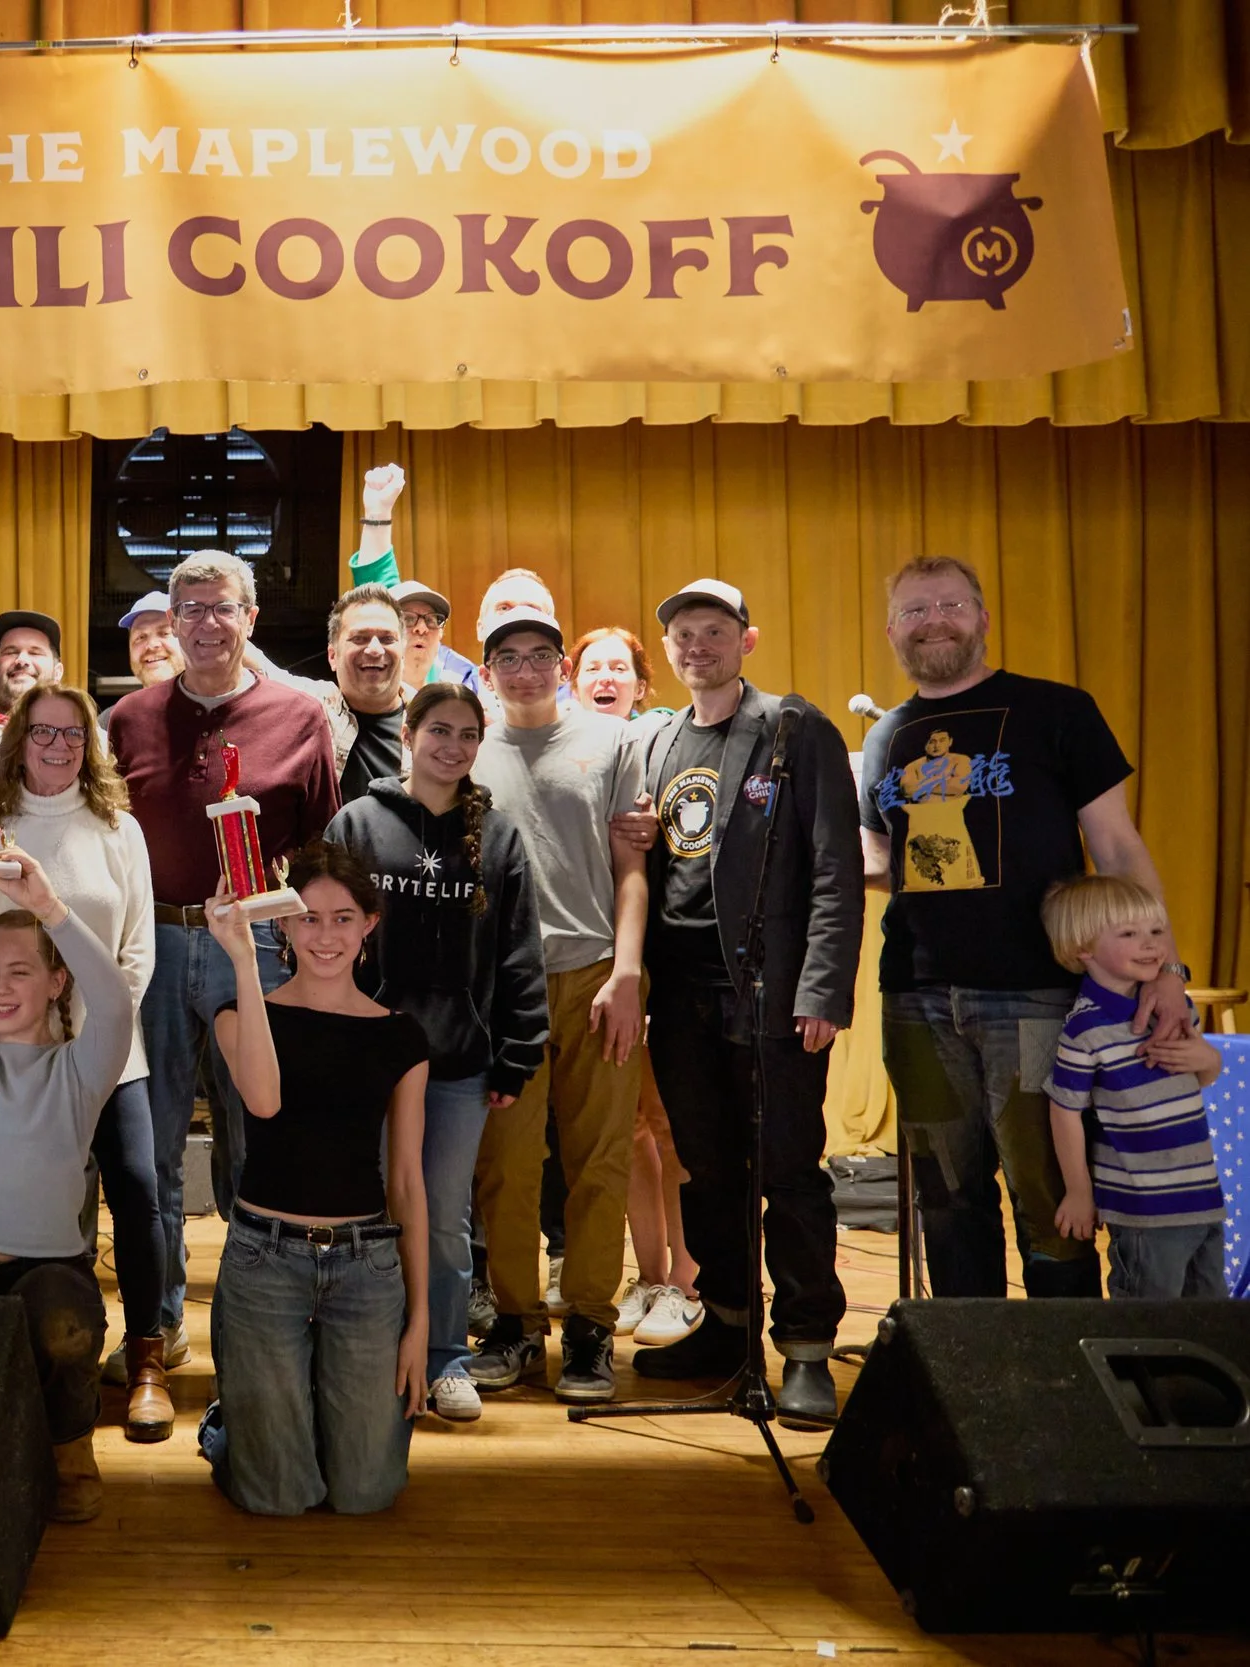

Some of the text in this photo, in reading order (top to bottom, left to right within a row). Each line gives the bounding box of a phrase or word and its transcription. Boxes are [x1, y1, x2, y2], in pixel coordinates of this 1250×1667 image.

[121, 124, 653, 180] MAPLEWOOD
[168, 213, 795, 301] COOKOFF
[976, 240, 1002, 262] M
[666, 775, 717, 803] THE MAPLEWO
[746, 781, 771, 792] TEAM
[748, 788, 771, 800] CHIL
[682, 832, 713, 850] COOKO
[369, 872, 475, 899] BRYTELIF
